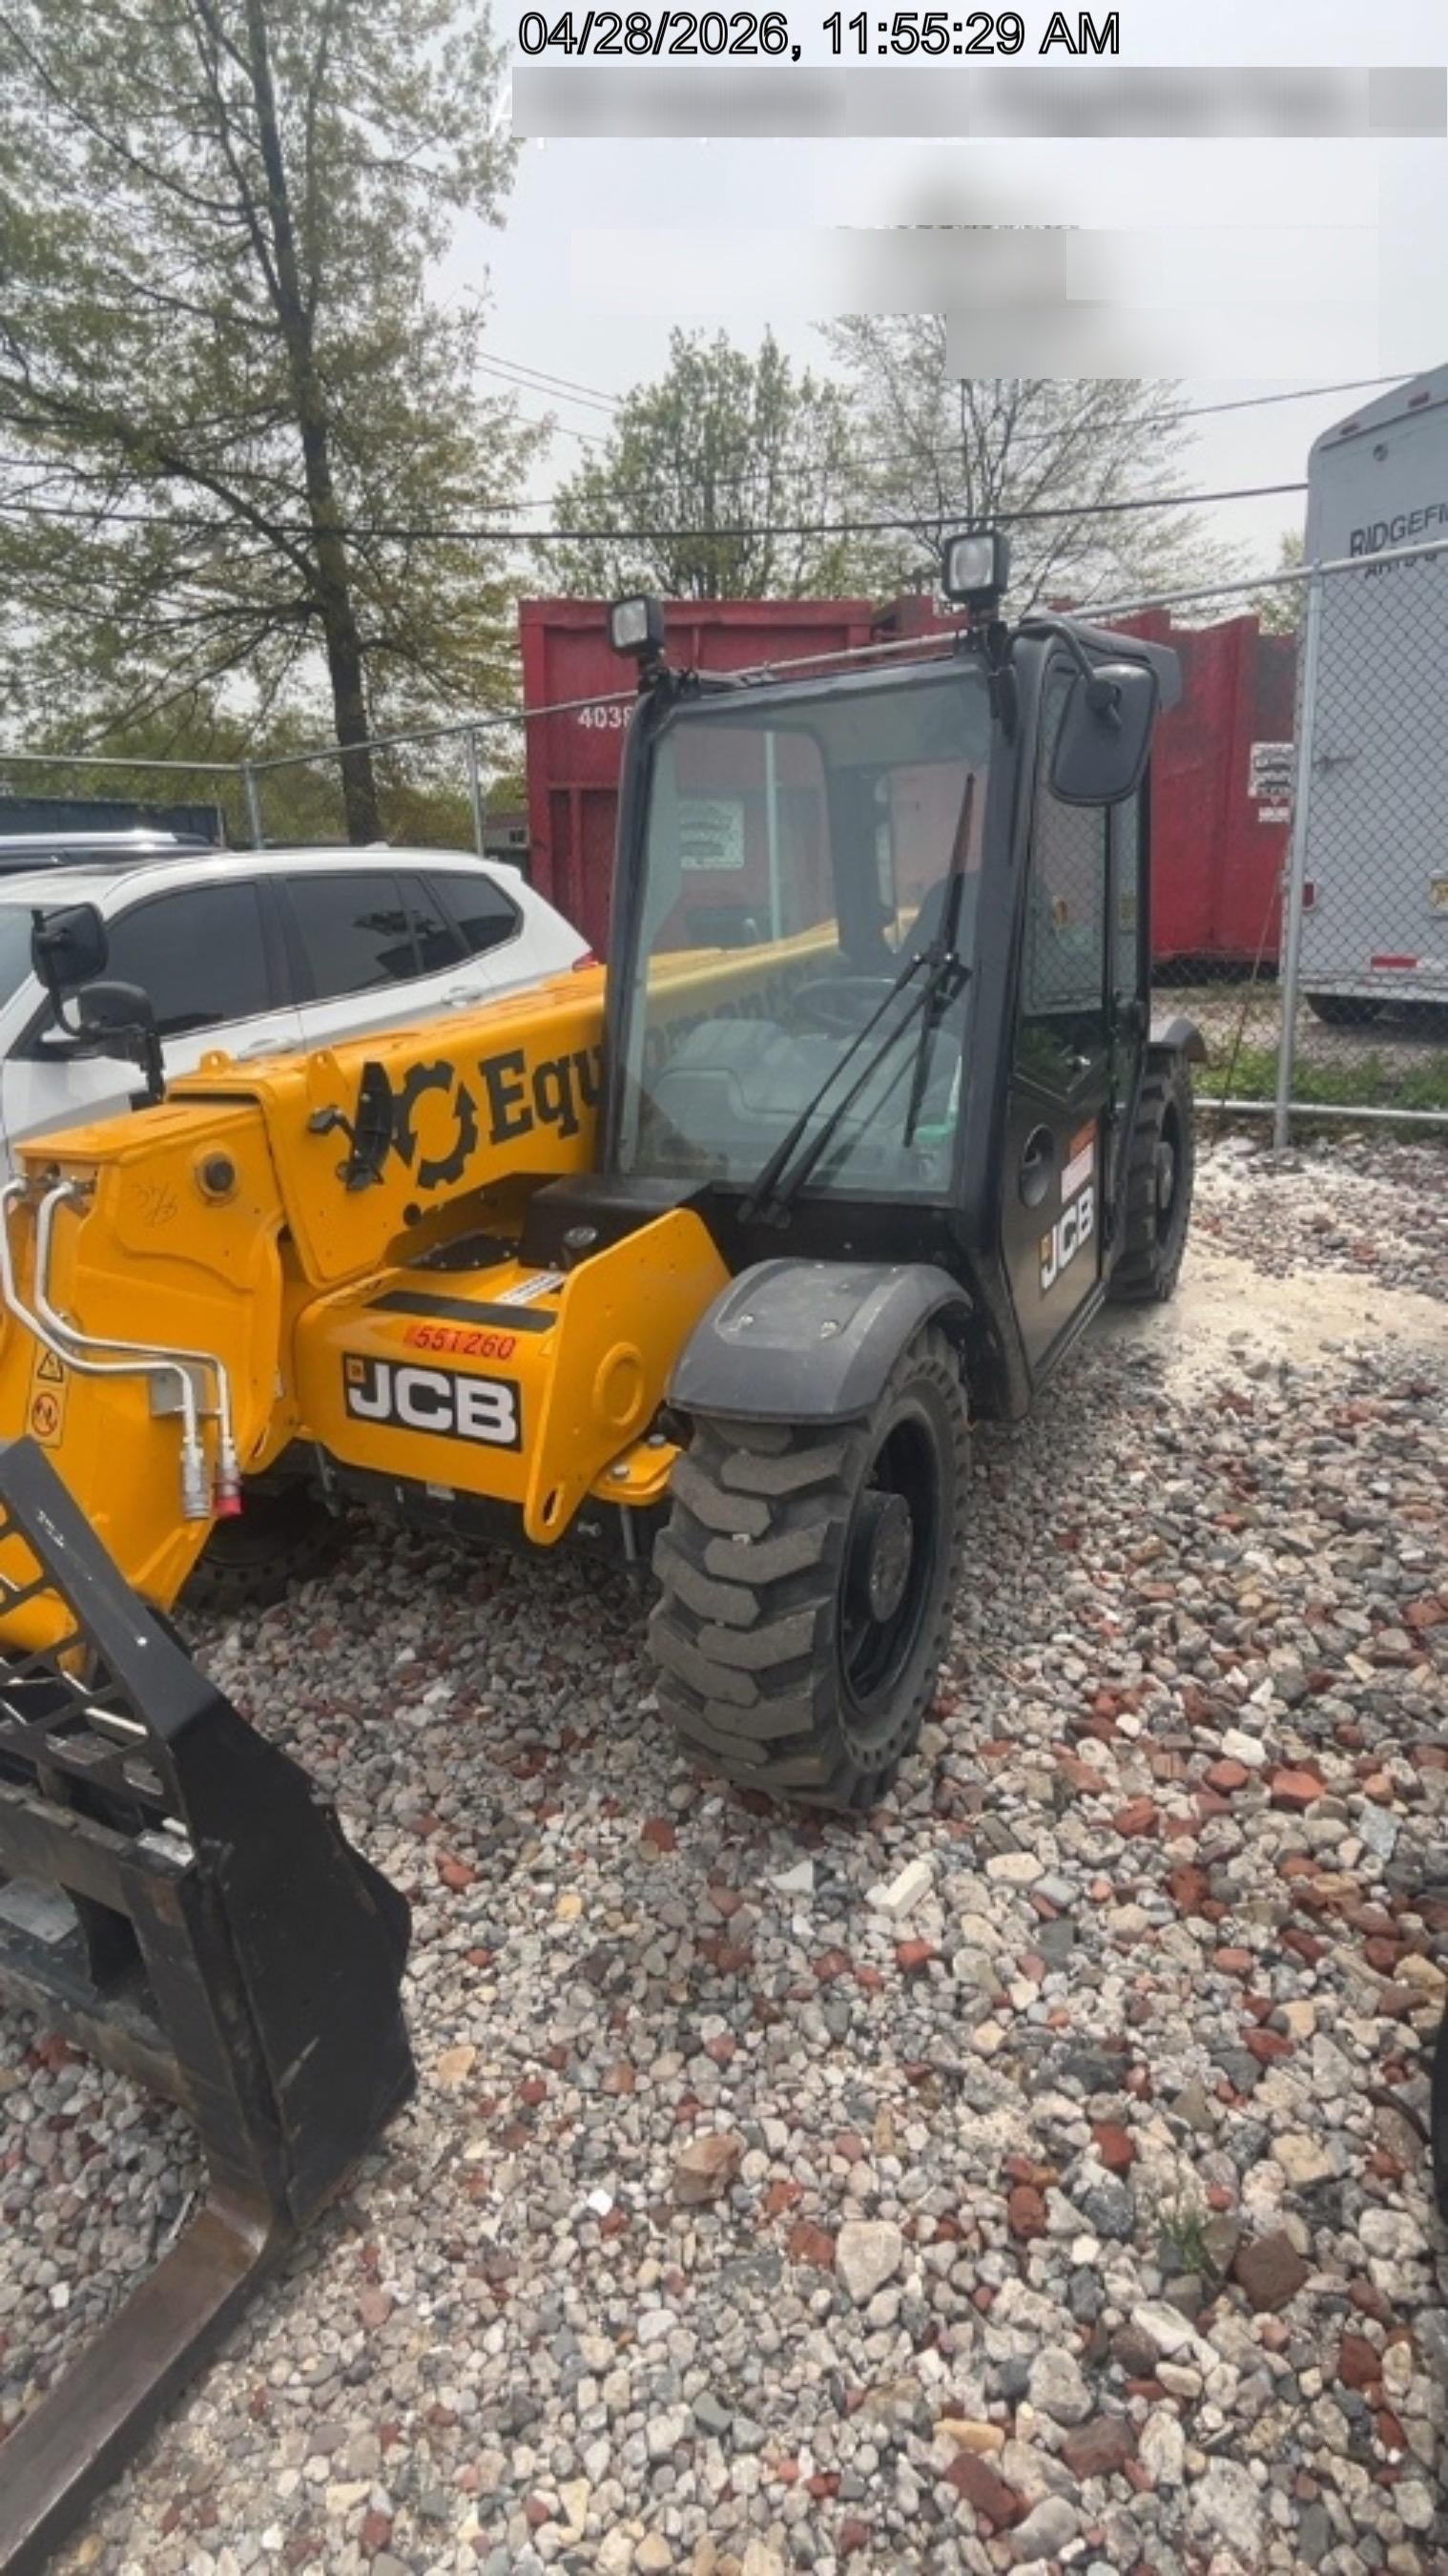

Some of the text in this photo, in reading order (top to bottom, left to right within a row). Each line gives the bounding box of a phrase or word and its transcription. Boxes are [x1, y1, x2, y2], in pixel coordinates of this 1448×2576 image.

[1350, 502, 1448, 558] RIDGEFI
[479, 1046, 610, 1145] Equ
[1041, 1185, 1094, 1290] JCB
[415, 1325, 516, 1360] 551260
[348, 1362, 517, 1444] JCB
